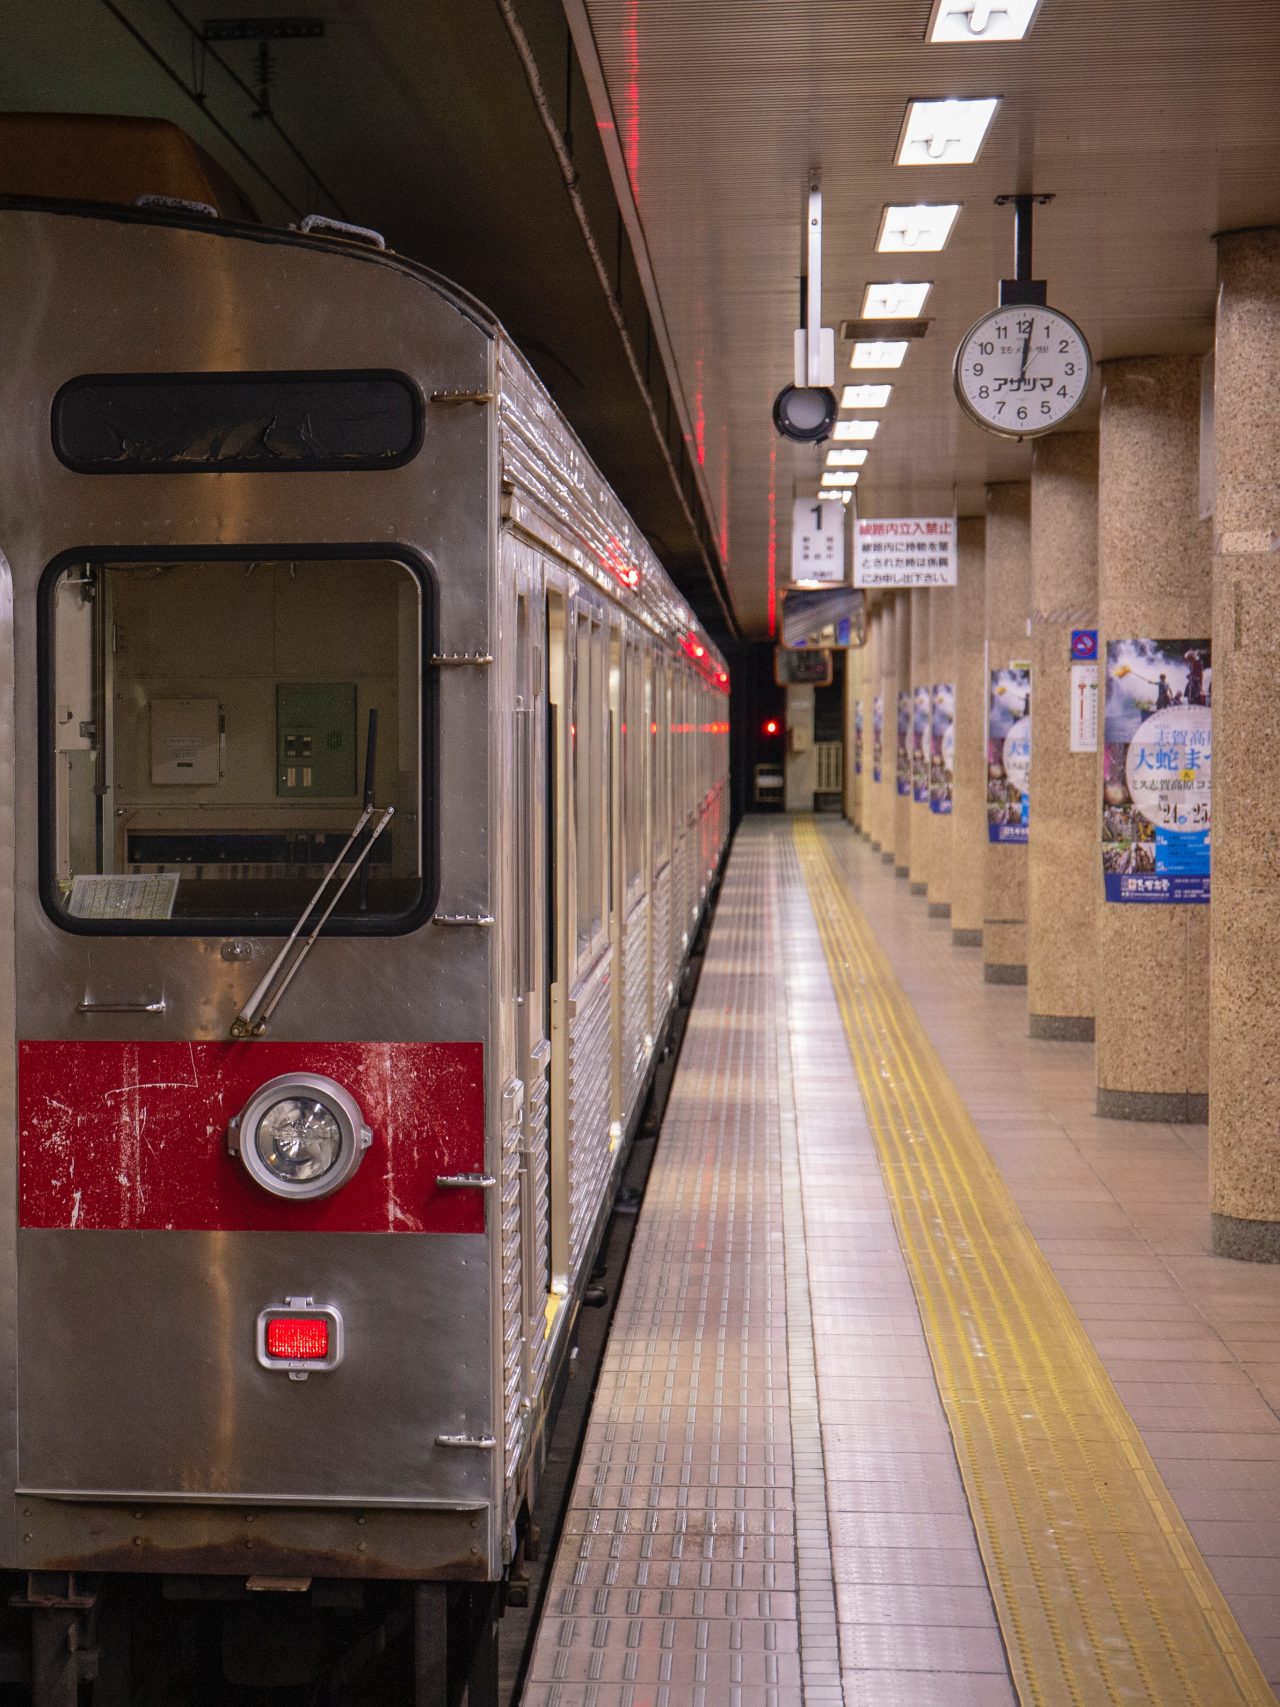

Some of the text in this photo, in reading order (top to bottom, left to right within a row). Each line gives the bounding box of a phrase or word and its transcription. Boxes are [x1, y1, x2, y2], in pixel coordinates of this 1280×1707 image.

[996, 326, 1008, 339] 11
[1016, 320, 1031, 334] 12
[1044, 326, 1050, 339] 1
[979, 342, 994, 355] 10
[1059, 340, 1069, 353] 2
[973, 363, 984, 376] 9
[1064, 362, 1075, 376] 3
[979, 386, 989, 399] 8
[1057, 385, 1068, 398] 4
[996, 402, 1006, 414] 7
[1017, 407, 1028, 420] 6
[1041, 401, 1051, 414] 5
[811, 505, 823, 530] 1
[860, 522, 952, 536] 線路内立入禁止
